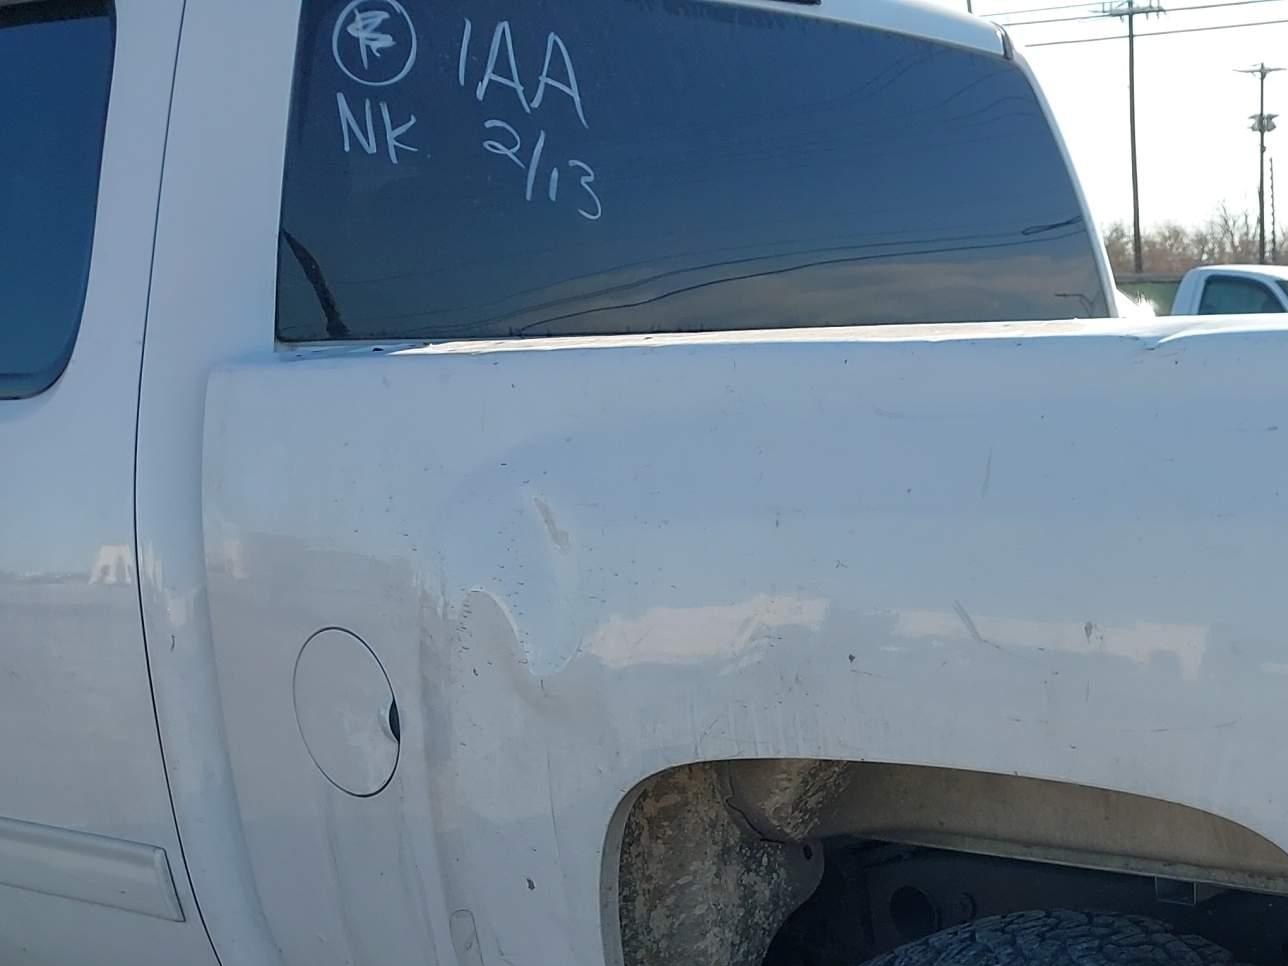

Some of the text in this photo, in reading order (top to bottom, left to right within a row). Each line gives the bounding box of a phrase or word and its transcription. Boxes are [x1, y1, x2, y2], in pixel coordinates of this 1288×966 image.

[458, 18, 590, 129] IAA
[335, 91, 419, 164] NK
[483, 119, 602, 220] 2/13
